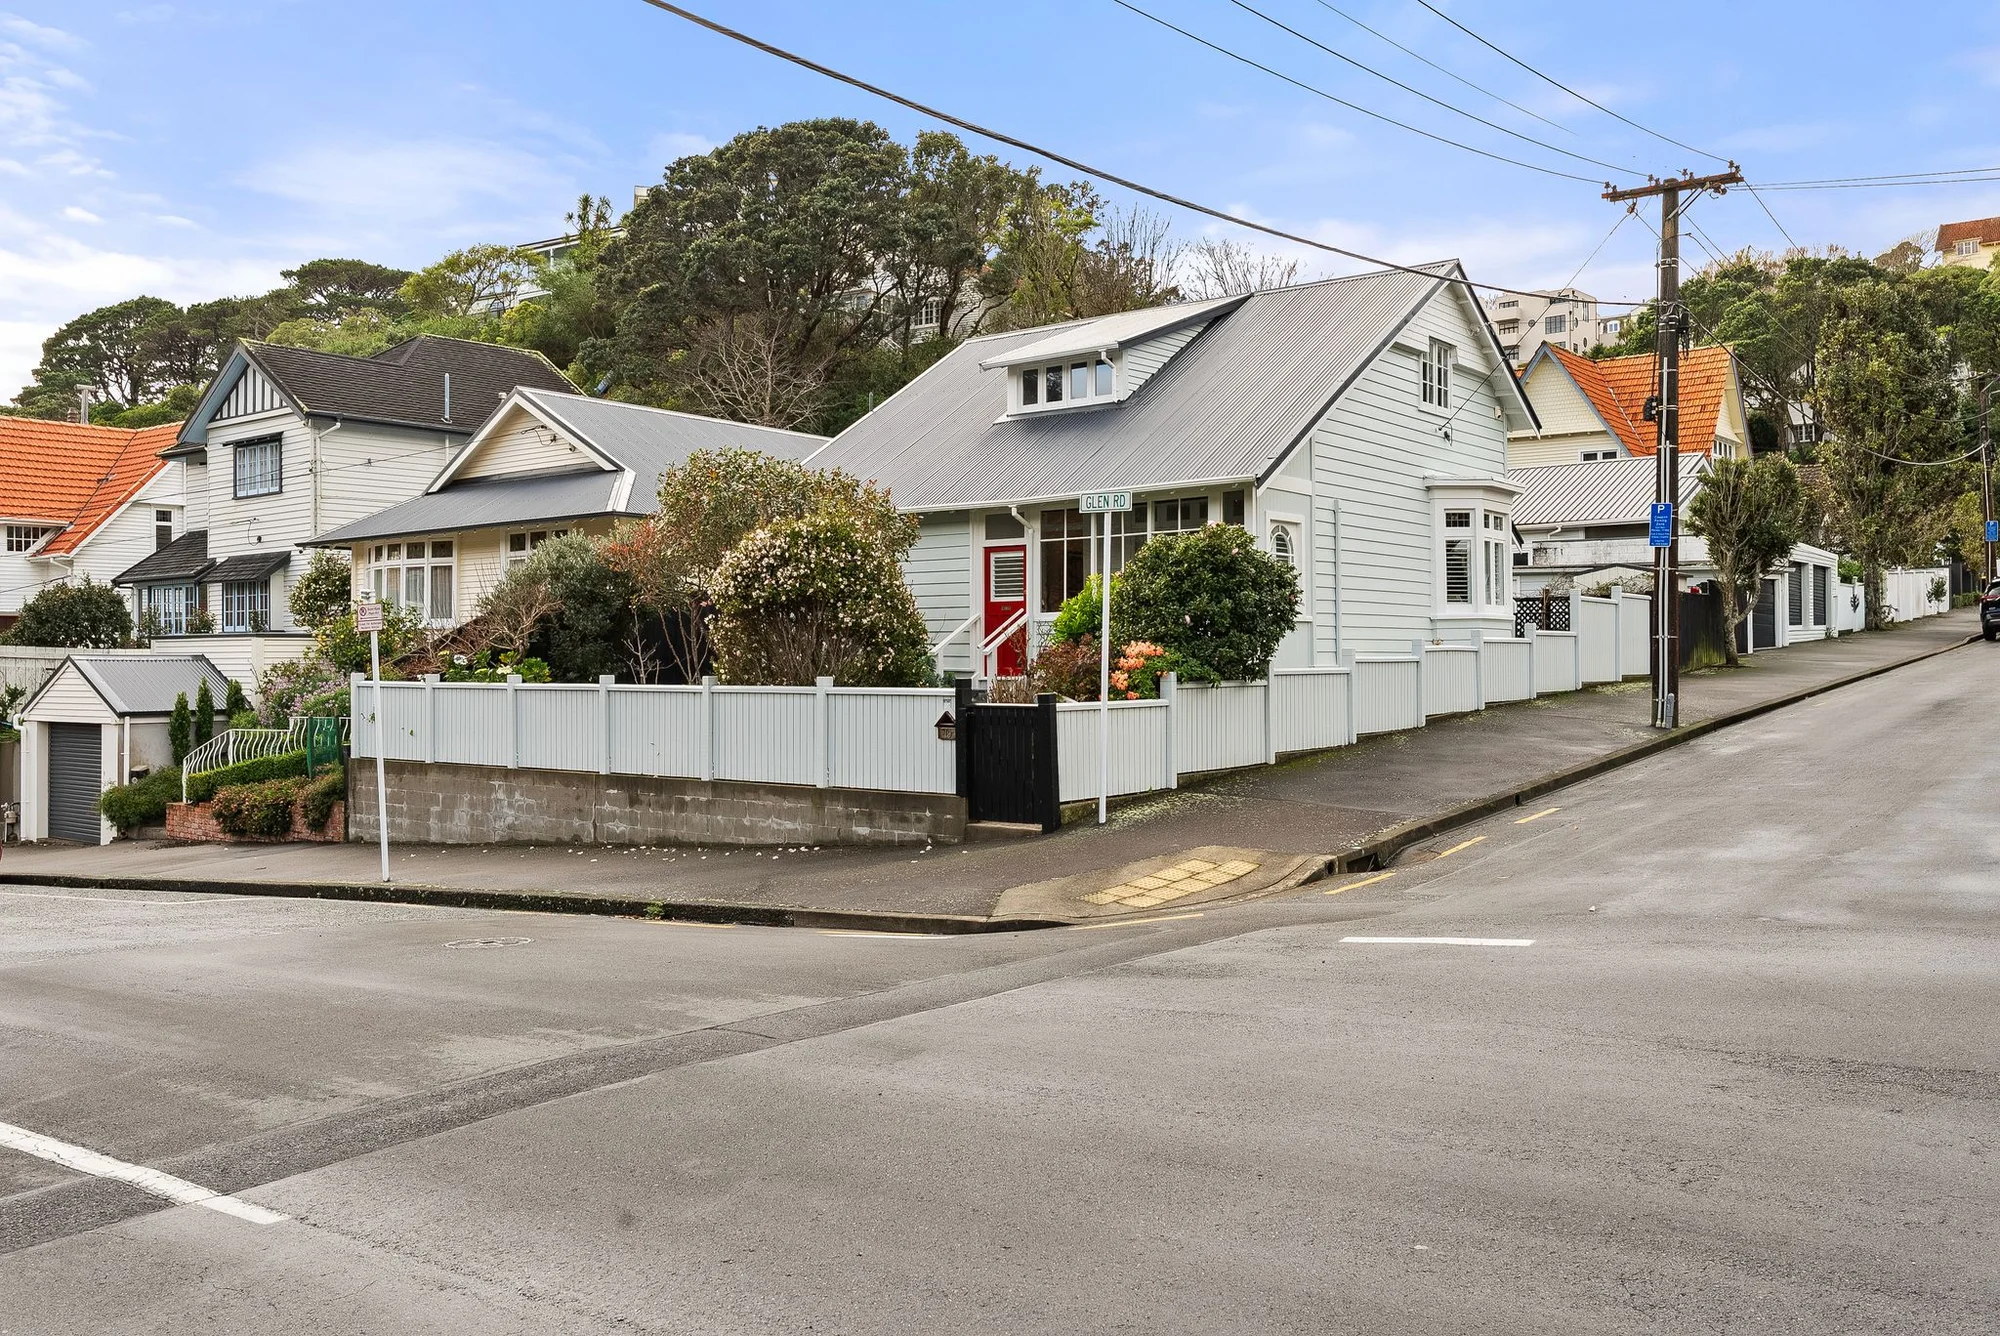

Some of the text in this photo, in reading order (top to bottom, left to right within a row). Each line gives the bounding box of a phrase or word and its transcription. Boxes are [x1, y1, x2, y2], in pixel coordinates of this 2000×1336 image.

[1086, 494, 1126, 509] GLEN RD
[1657, 504, 1665, 514] P
